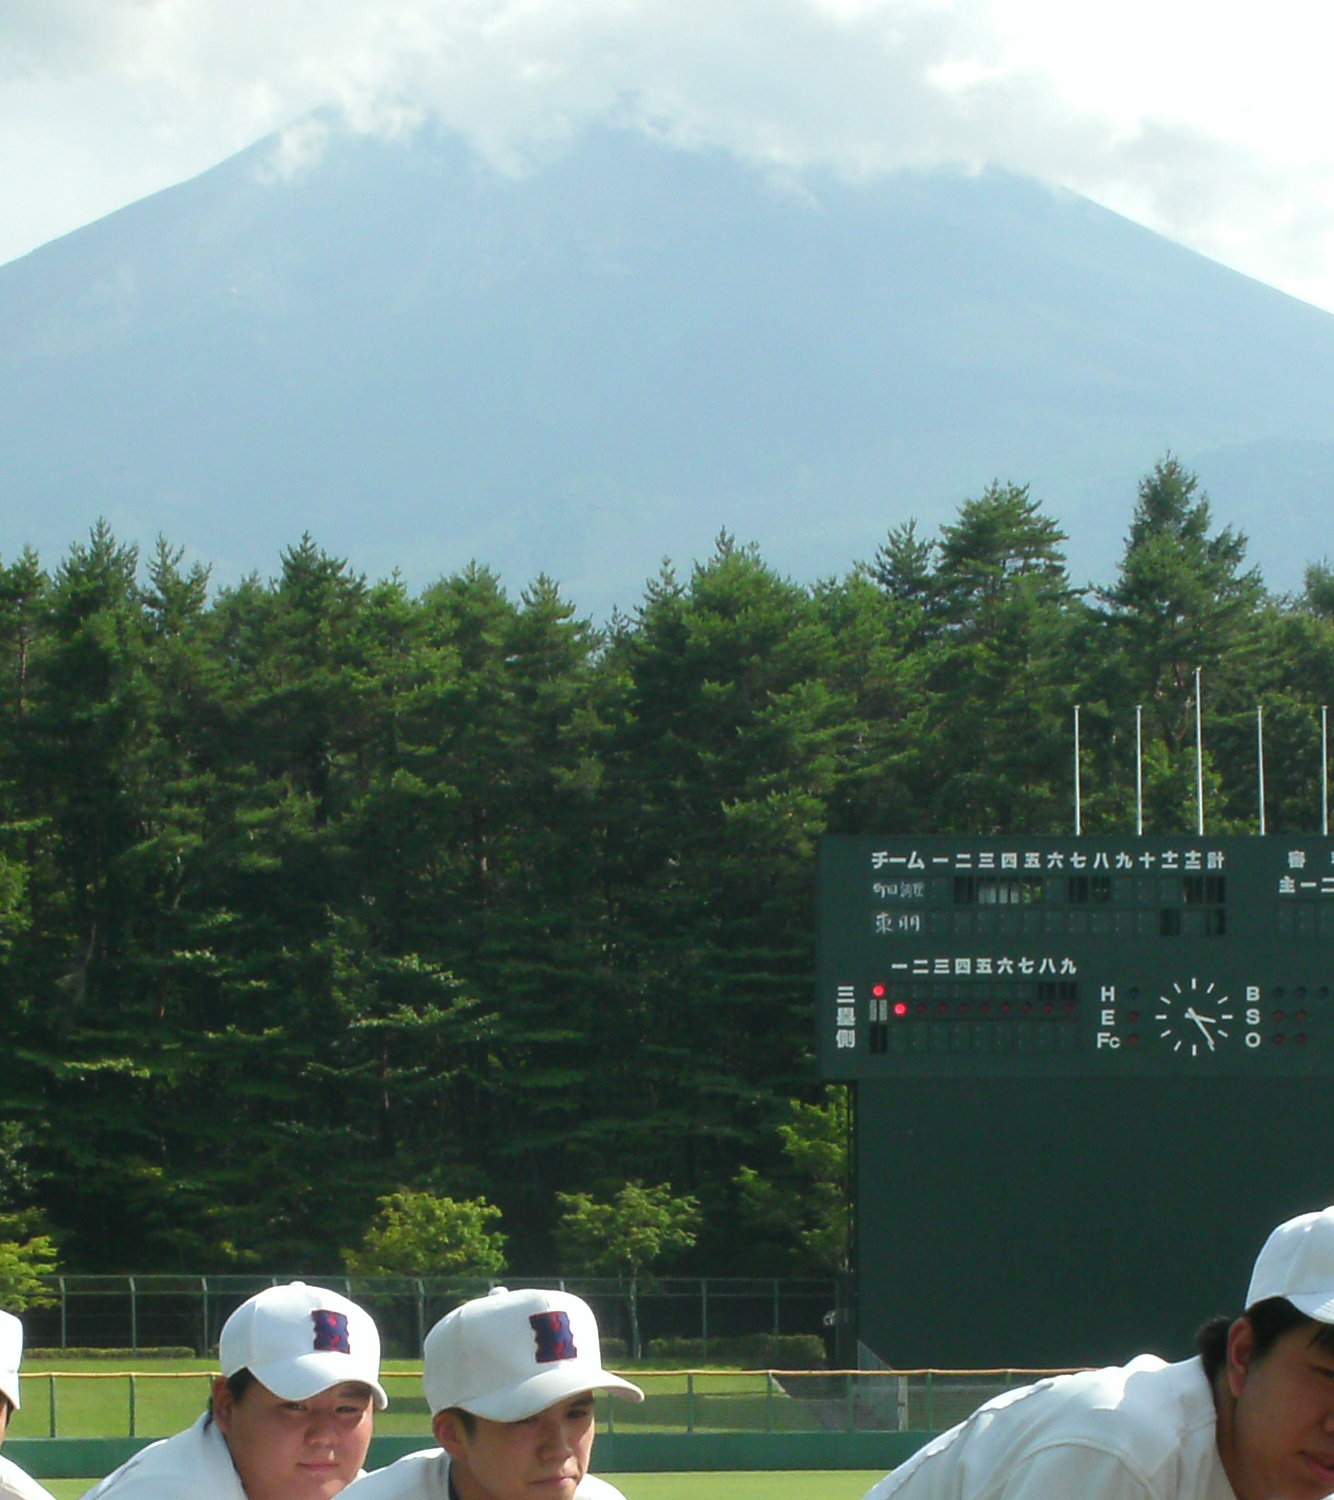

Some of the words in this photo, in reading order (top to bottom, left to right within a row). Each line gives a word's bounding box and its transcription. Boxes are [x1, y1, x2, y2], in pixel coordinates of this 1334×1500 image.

[871, 850, 925, 870] チーム
[1101, 986, 1115, 1002] H
[1246, 986, 1260, 1002] B
[1101, 1009, 1115, 1026] E
[1245, 1008, 1261, 1025] S
[1245, 1031, 1261, 1048] O
